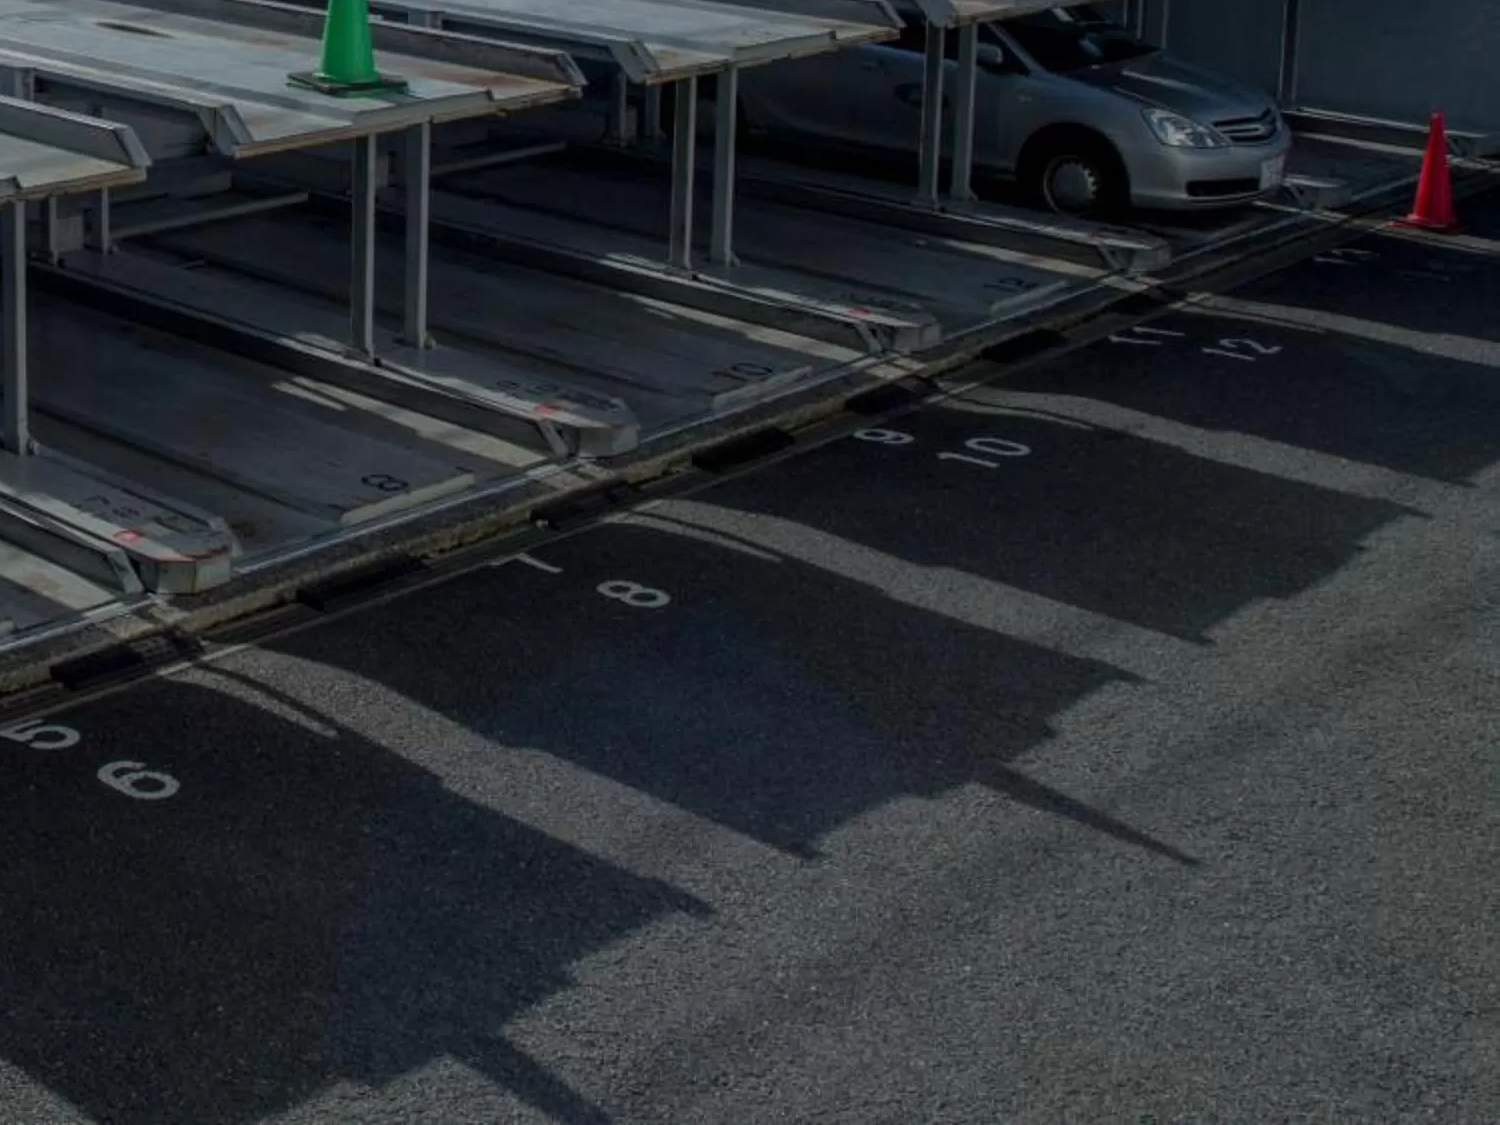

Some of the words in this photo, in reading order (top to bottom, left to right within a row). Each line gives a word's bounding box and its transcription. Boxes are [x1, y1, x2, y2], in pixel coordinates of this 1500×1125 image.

[1202, 337, 1282, 362] 12
[853, 428, 915, 444] 9
[936, 437, 1032, 468] 10
[361, 474, 409, 491] 8
[596, 579, 671, 608] 8
[97, 760, 181, 801] 6
